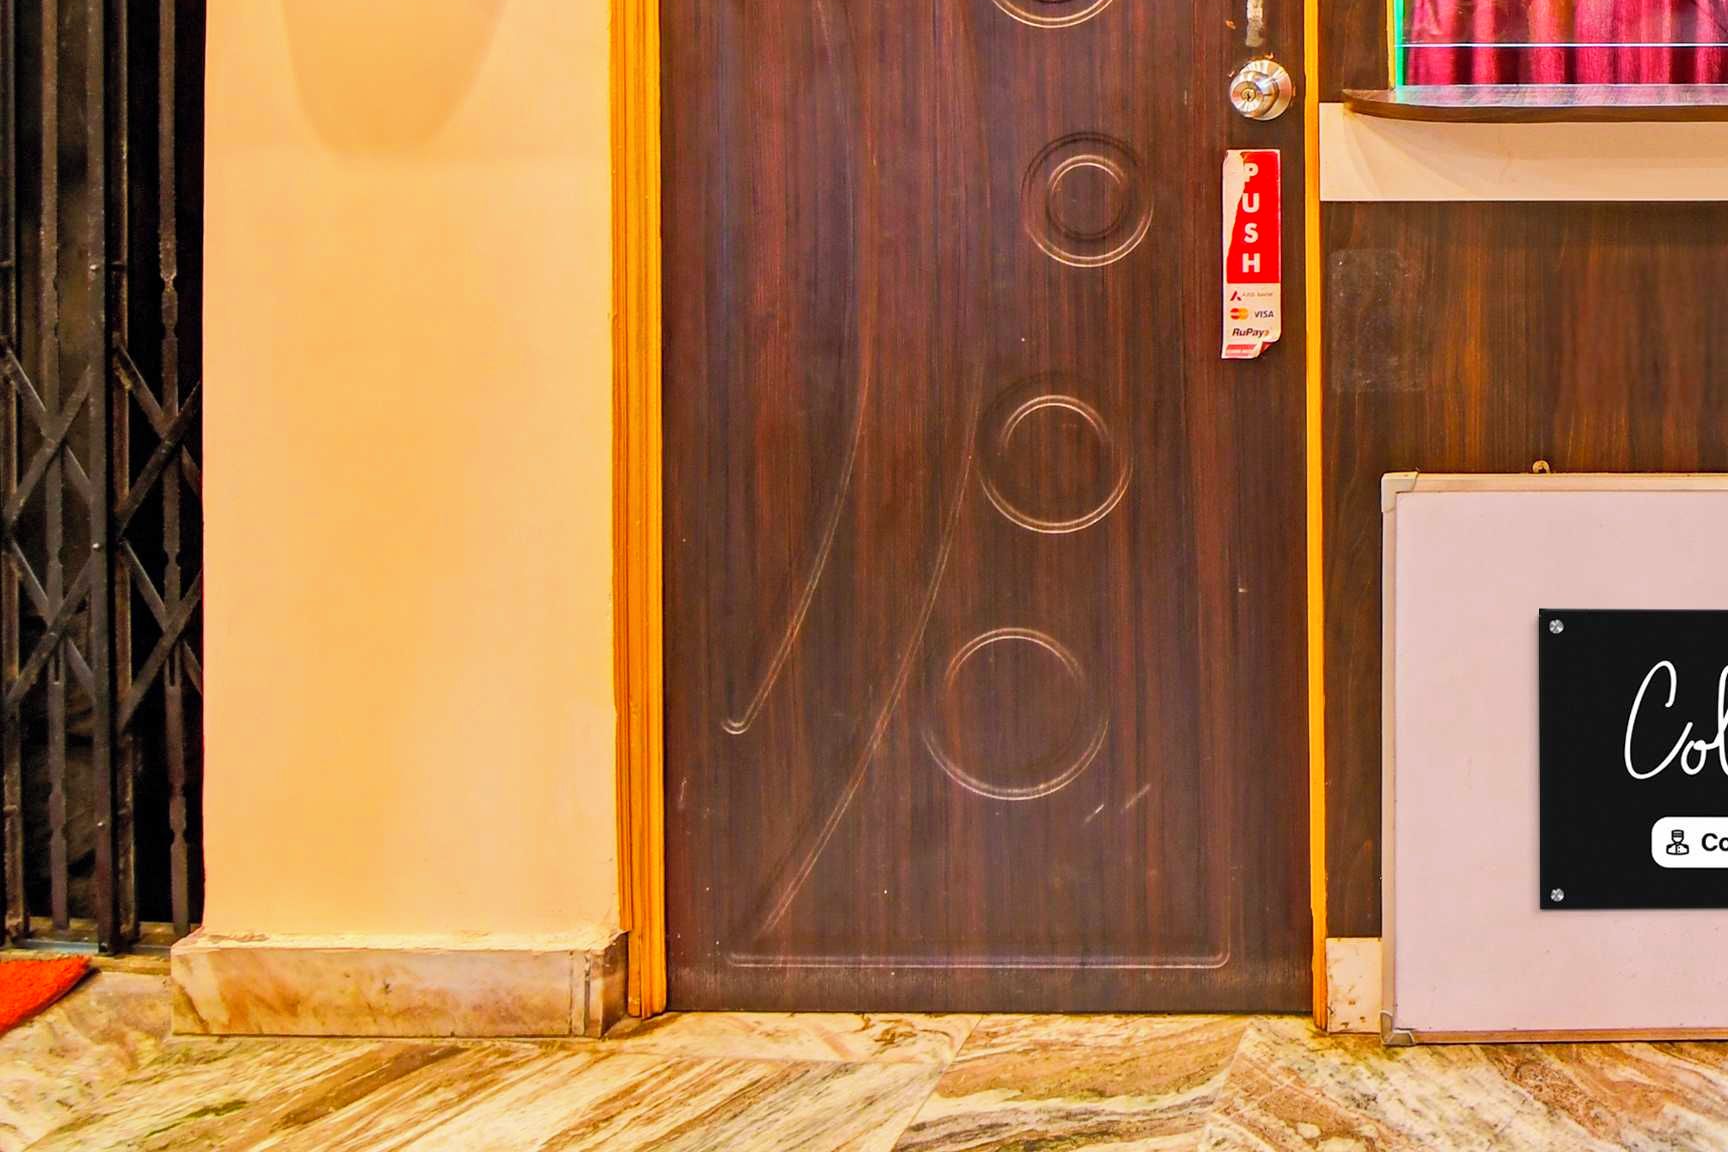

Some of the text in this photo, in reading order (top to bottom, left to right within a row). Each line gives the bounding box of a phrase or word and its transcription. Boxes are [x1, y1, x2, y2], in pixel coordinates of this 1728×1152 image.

[1241, 162, 1261, 273] PUSH
[1254, 310, 1275, 319] VISA
[1231, 327, 1265, 339] RuPay
